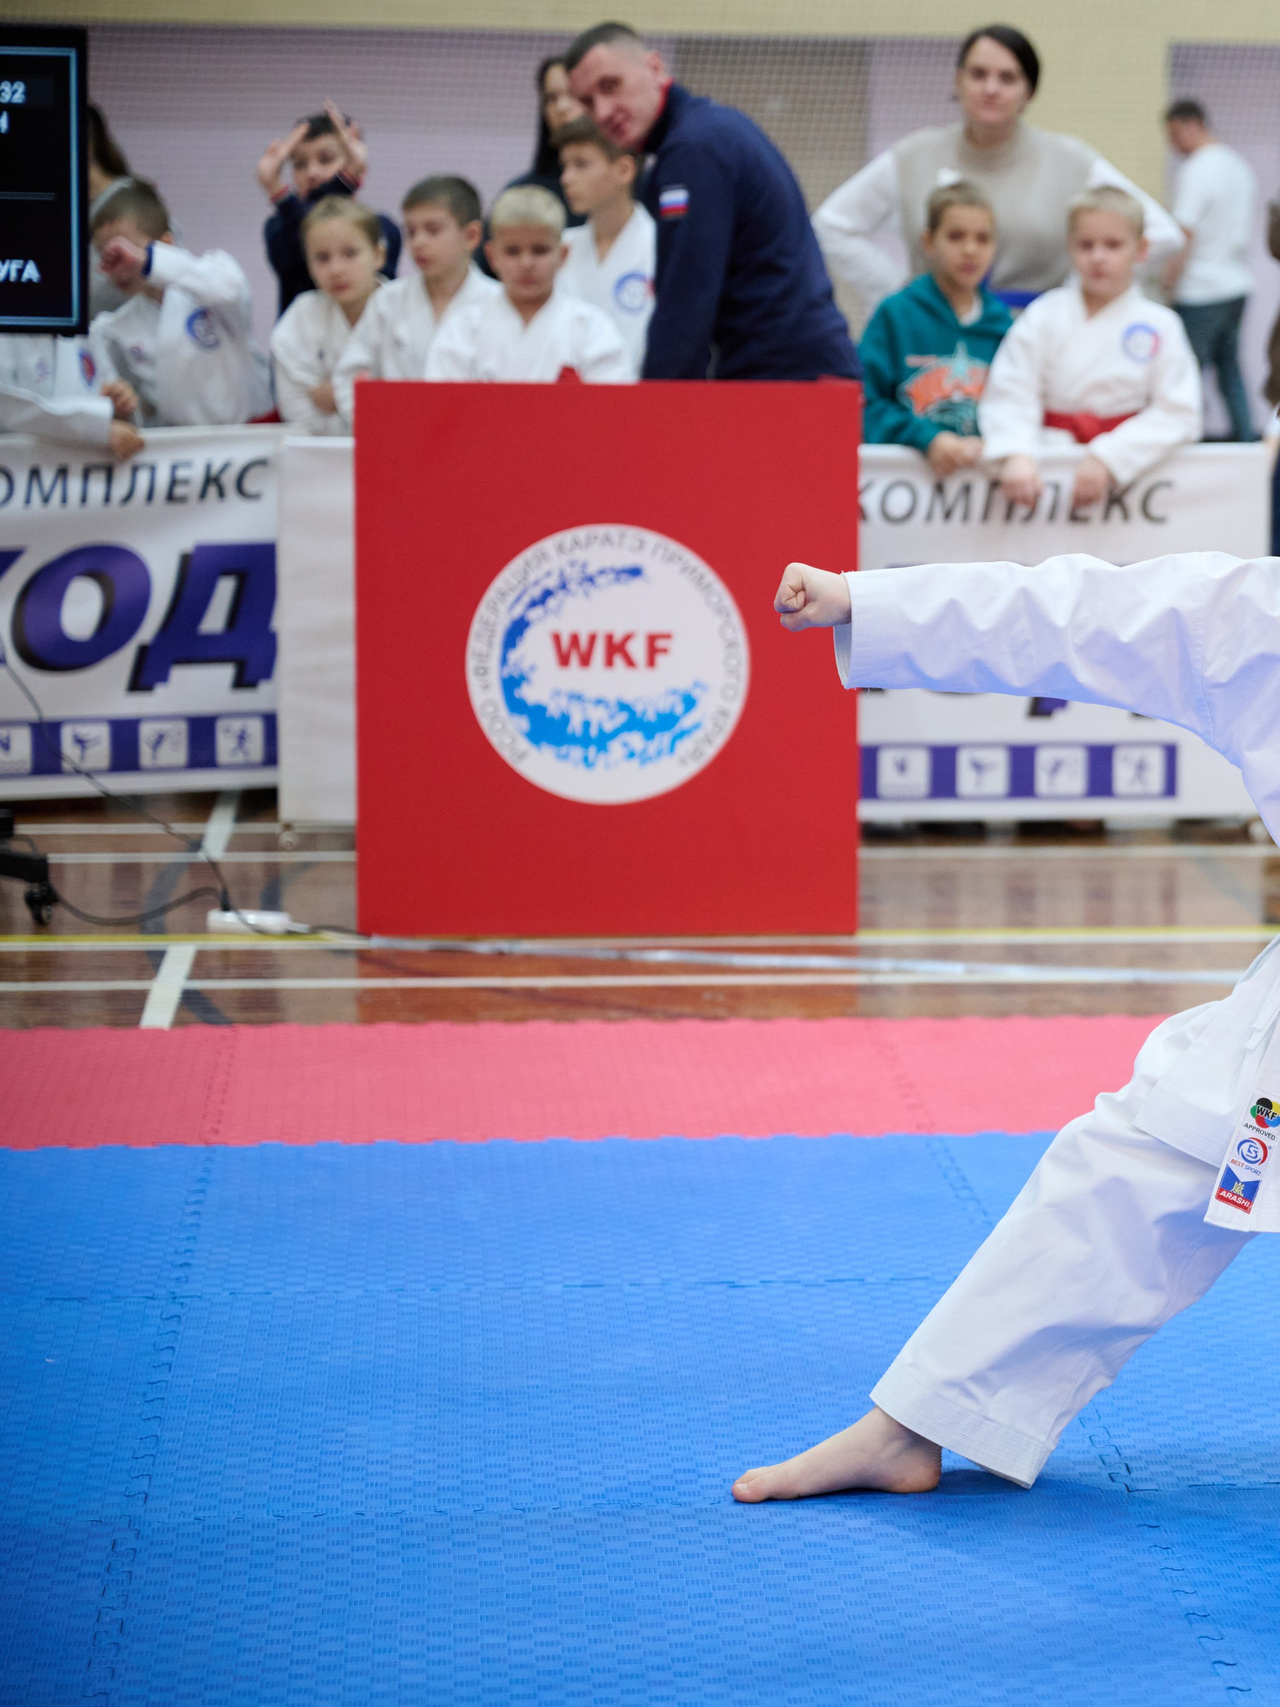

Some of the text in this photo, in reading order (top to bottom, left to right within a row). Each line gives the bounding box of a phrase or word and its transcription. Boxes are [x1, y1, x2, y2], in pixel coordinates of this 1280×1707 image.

[553, 632, 673, 669] WKF
[1256, 1105, 1278, 1120] WKF
[1243, 1122, 1276, 1141] APPROVED
[1230, 1158, 1262, 1176] BEST SPORT
[1219, 1190, 1251, 1208] ARASHI
